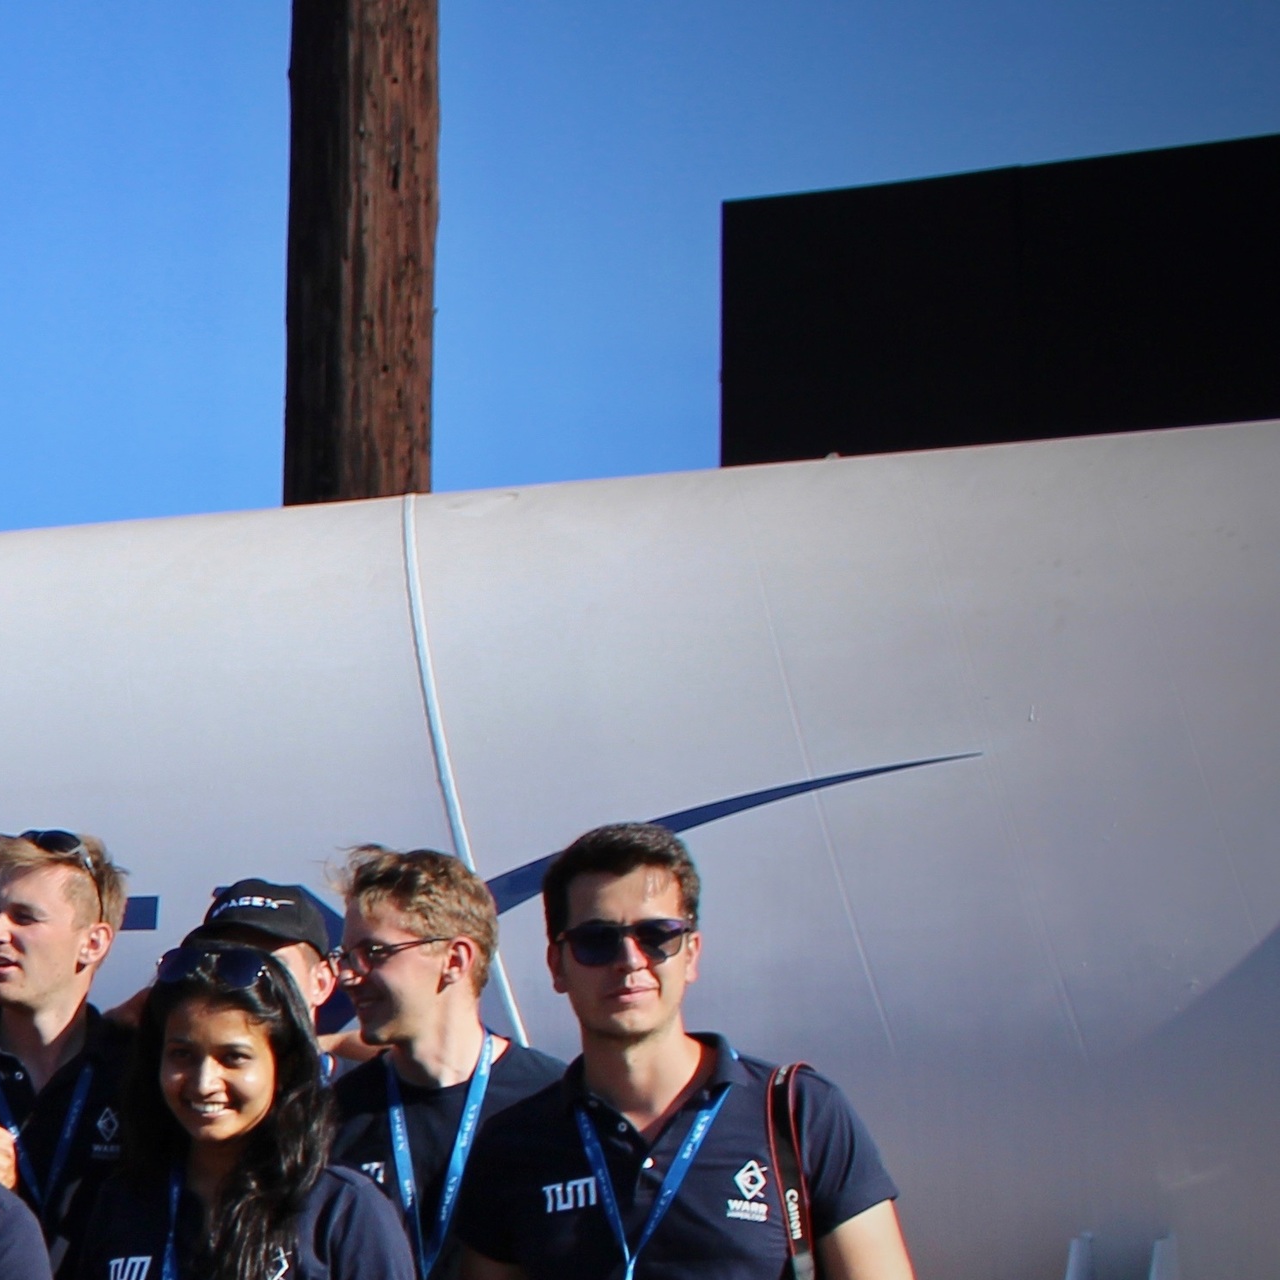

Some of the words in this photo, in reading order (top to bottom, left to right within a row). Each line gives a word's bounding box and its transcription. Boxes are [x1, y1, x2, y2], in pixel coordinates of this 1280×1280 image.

[212, 896, 295, 918] SPACEX
[461, 1104, 477, 1148] SPACEX
[682, 1115, 710, 1160] SPACEX
[441, 1176, 457, 1221] SPACEX
[542, 1176, 597, 1213] TUM
[727, 1199, 768, 1214] WARR
[785, 1188, 802, 1240] Canon
